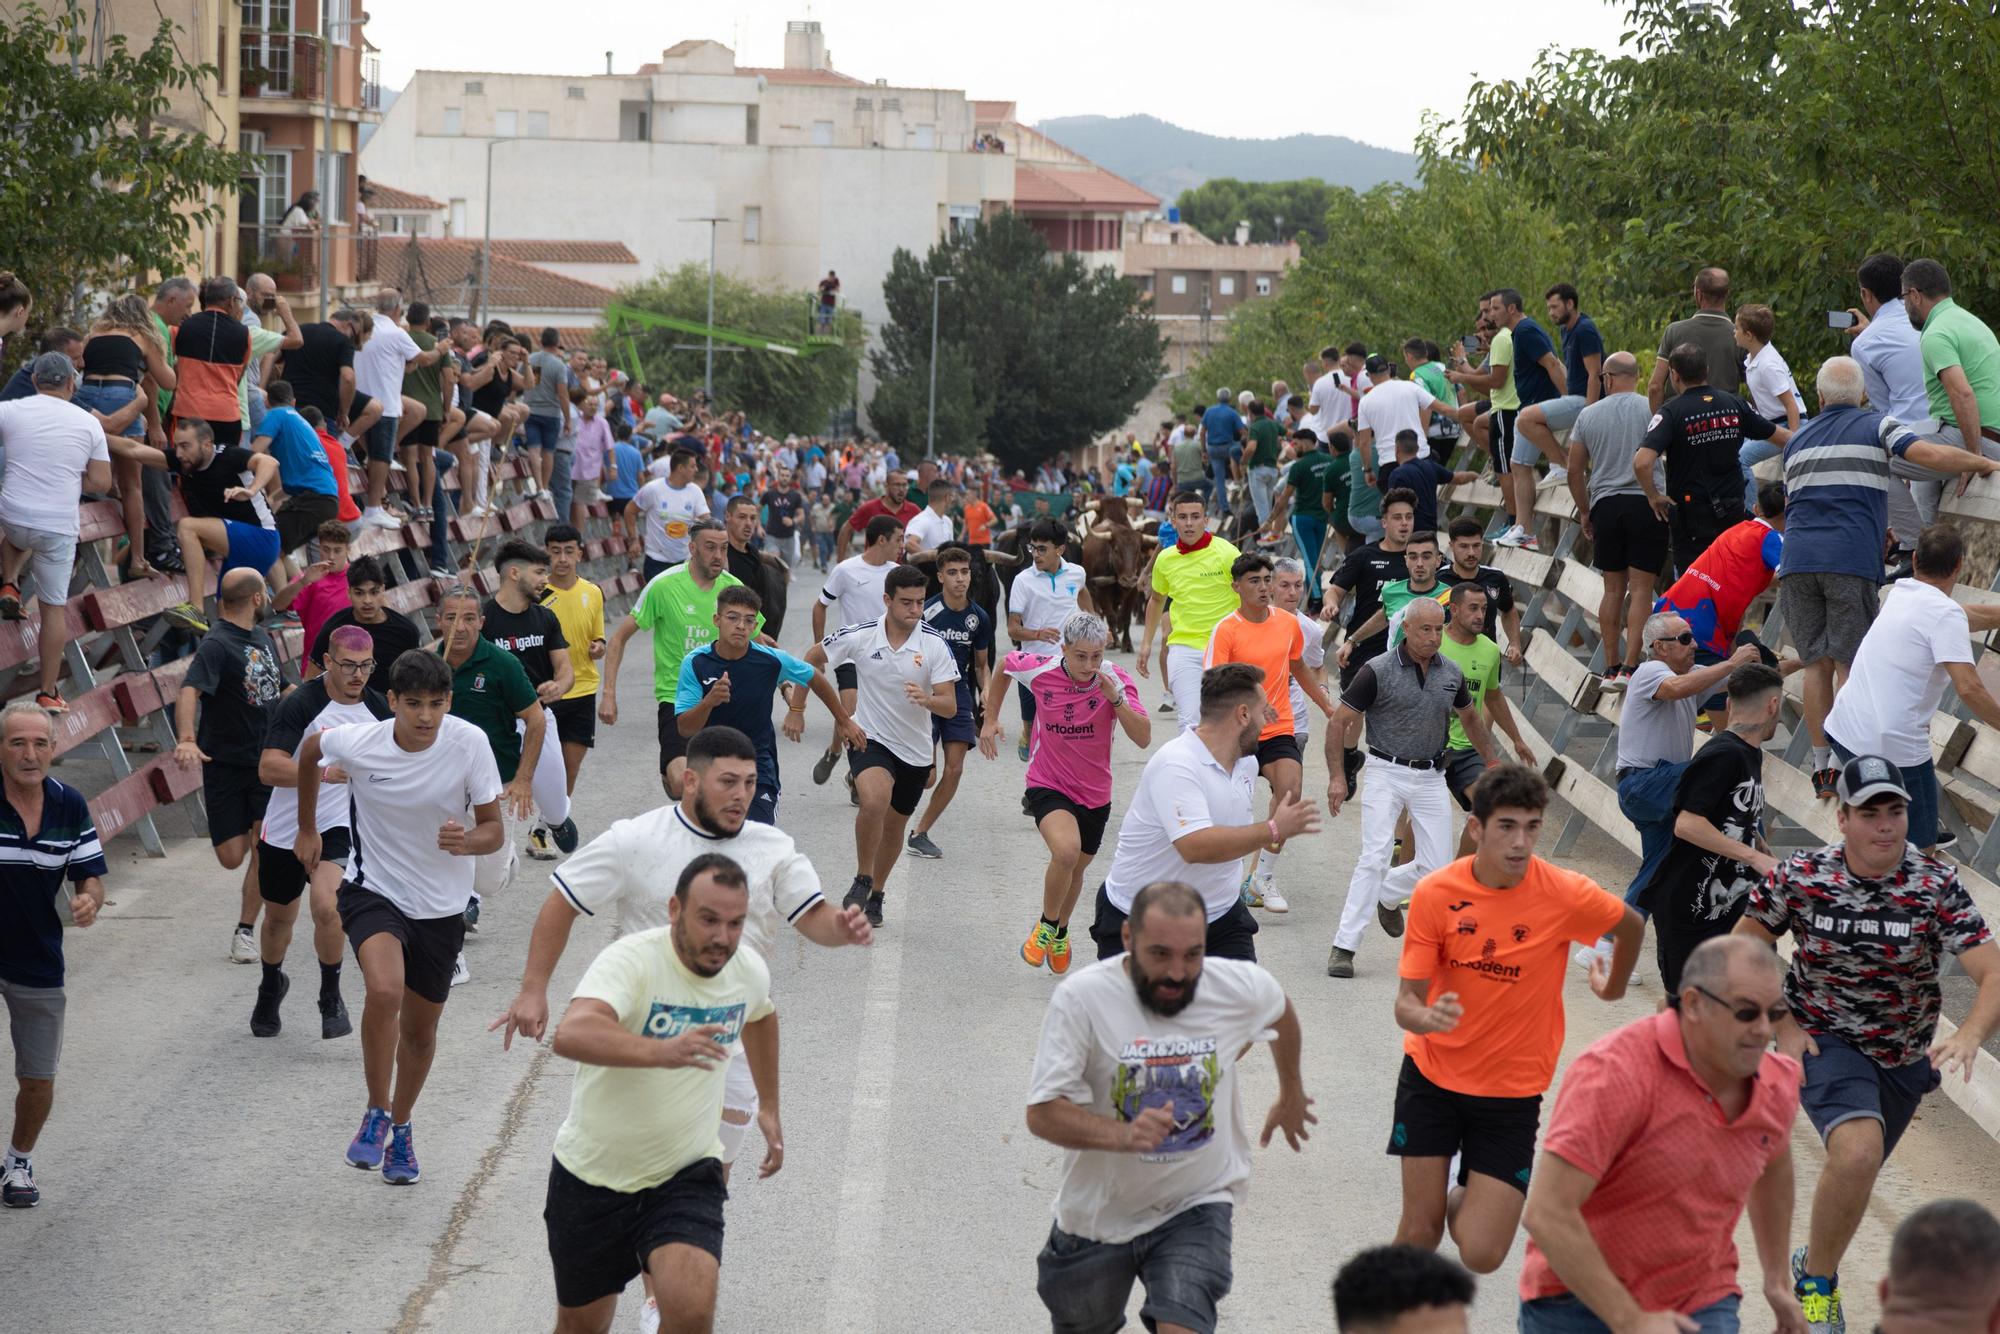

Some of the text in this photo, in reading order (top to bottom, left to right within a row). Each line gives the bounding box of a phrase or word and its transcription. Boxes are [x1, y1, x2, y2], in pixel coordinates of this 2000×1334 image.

[1686, 420, 1708, 434] 112
[685, 624, 710, 638] Tío
[937, 628, 969, 641] oftee
[1045, 722, 1095, 735] ortodent
[1814, 913, 1910, 938] DO IT FOR YOU
[1120, 1038, 1216, 1060] JACK&JONES
